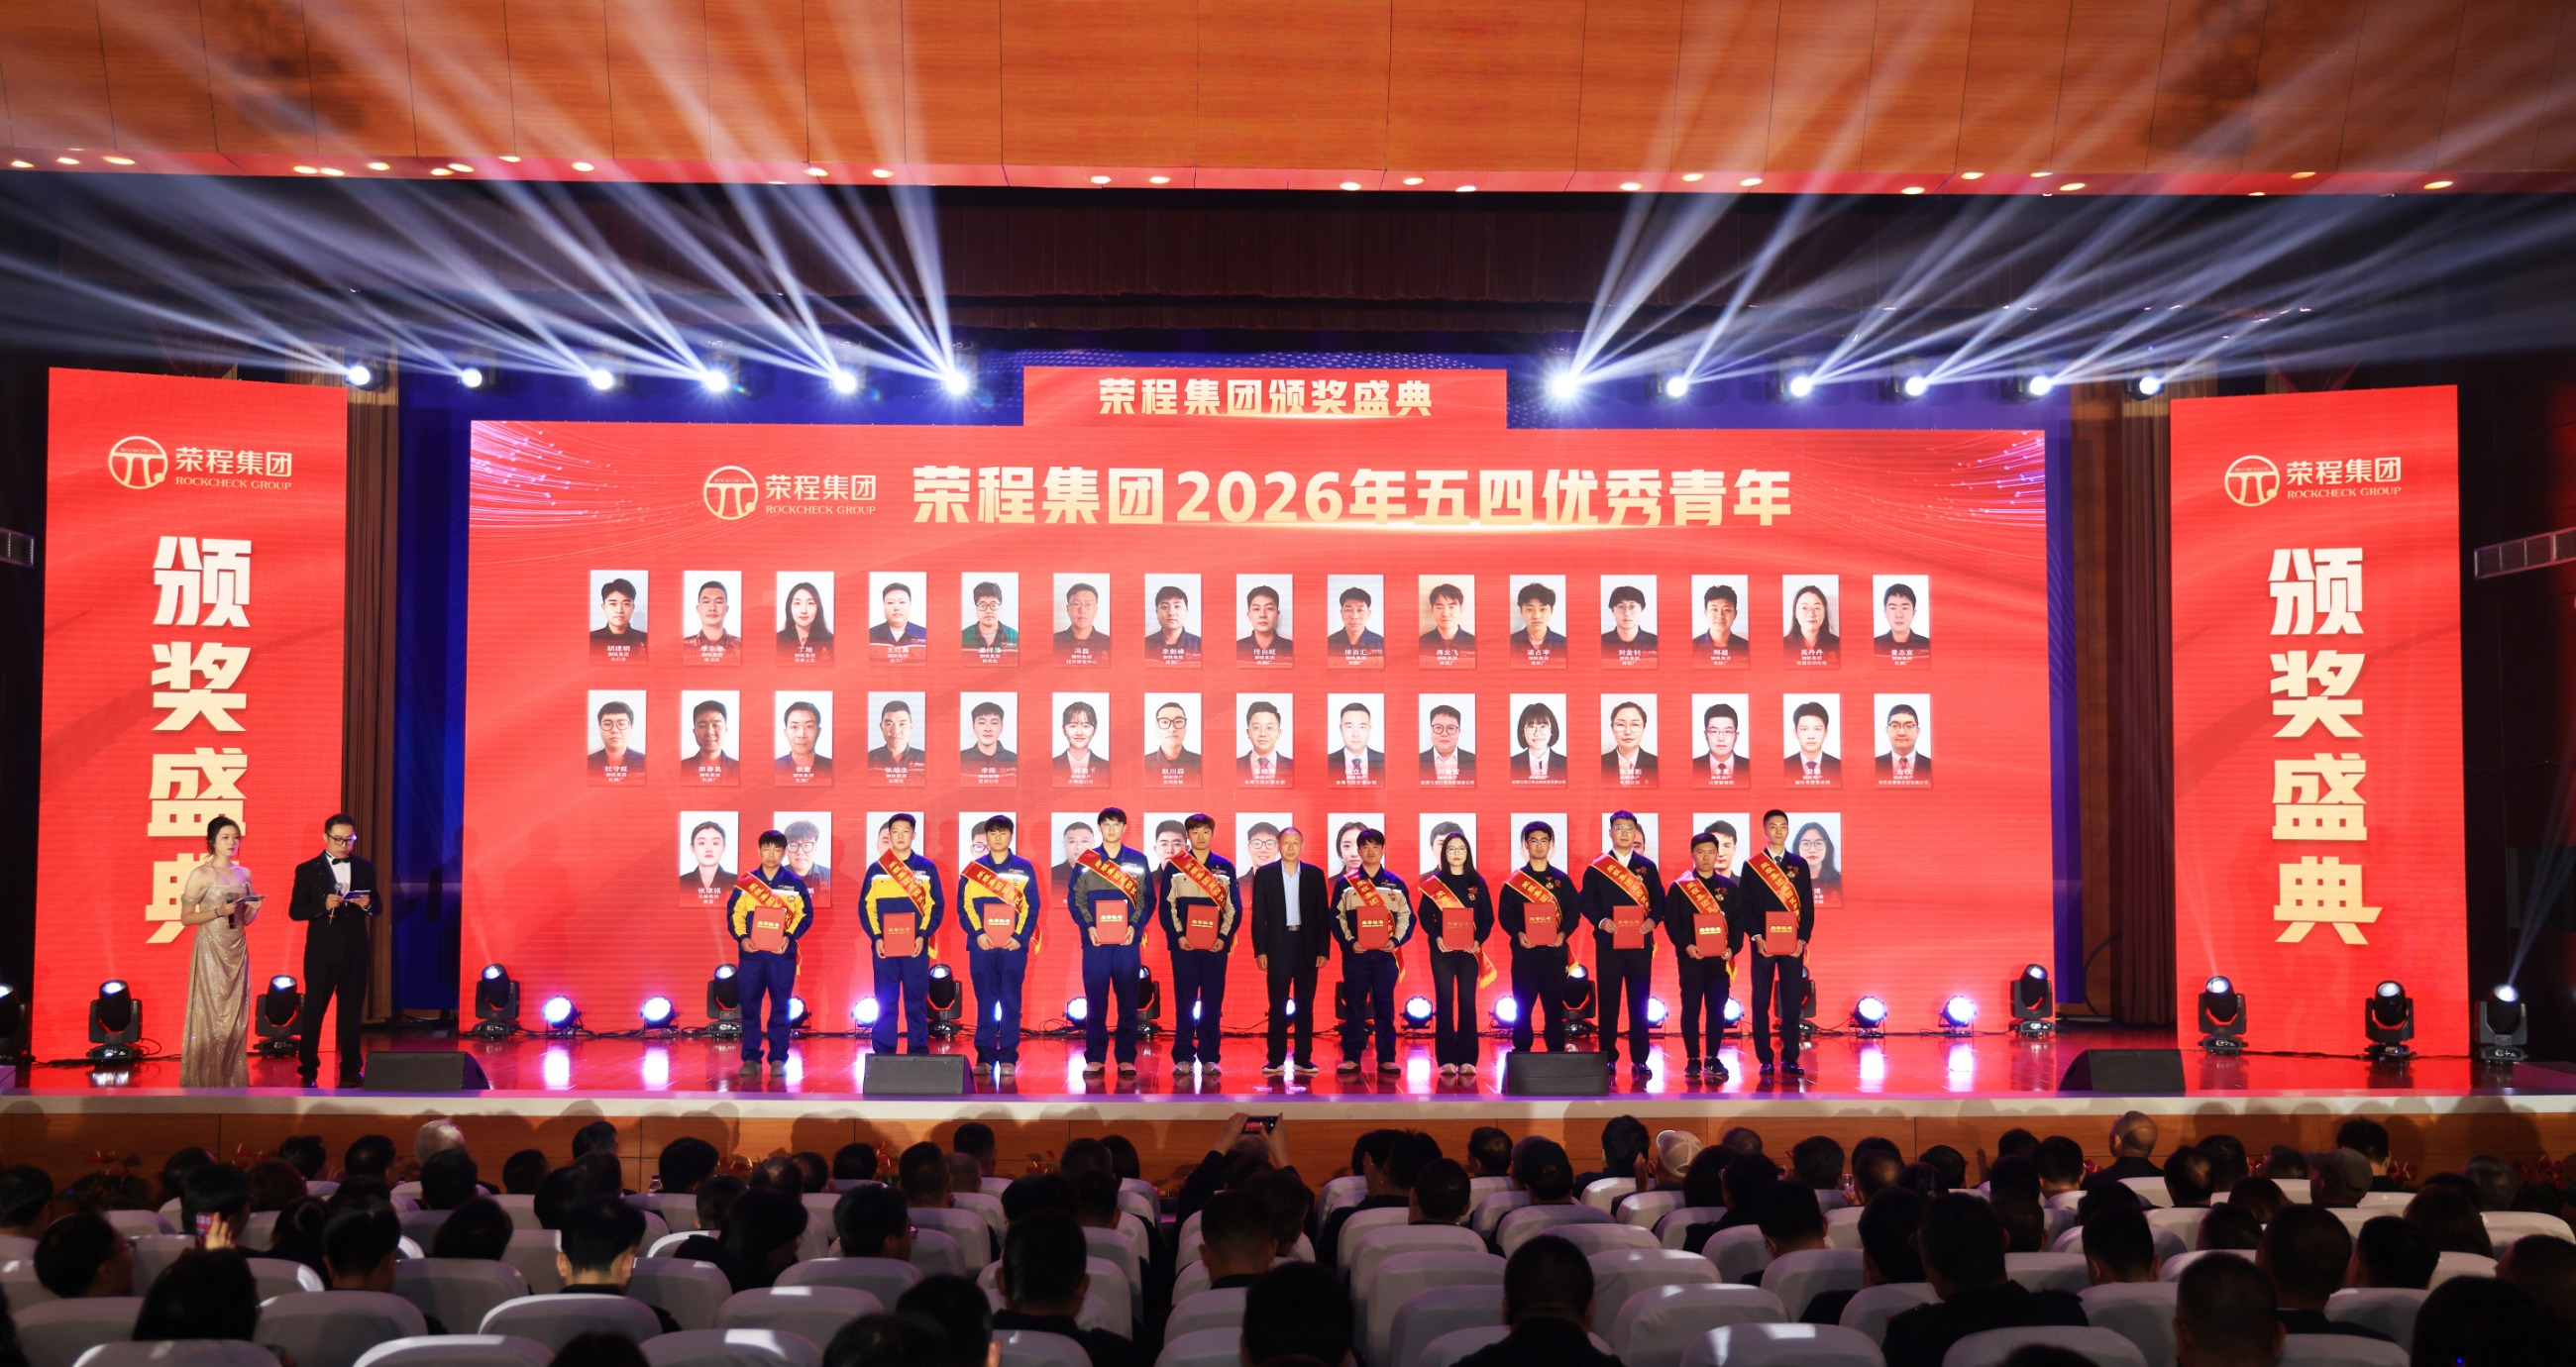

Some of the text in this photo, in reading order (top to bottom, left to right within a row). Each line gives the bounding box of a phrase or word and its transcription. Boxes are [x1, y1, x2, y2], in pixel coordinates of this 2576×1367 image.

[1099, 377, 1433, 417] 荣程集团颁奖盛典
[175, 447, 292, 477] 荣程集团
[2286, 456, 2402, 486] 荣程集团
[175, 476, 292, 490] ROCKCHECK GROUP
[765, 474, 877, 501] 荣程集团
[912, 465, 1791, 527] 荣程集团2026年五四优秀青年
[2287, 486, 2402, 499] ROCKCHECK GROUP
[765, 505, 877, 515] ROCKCHECK GROUP
[2268, 547, 2383, 946] 颁奖盛典
